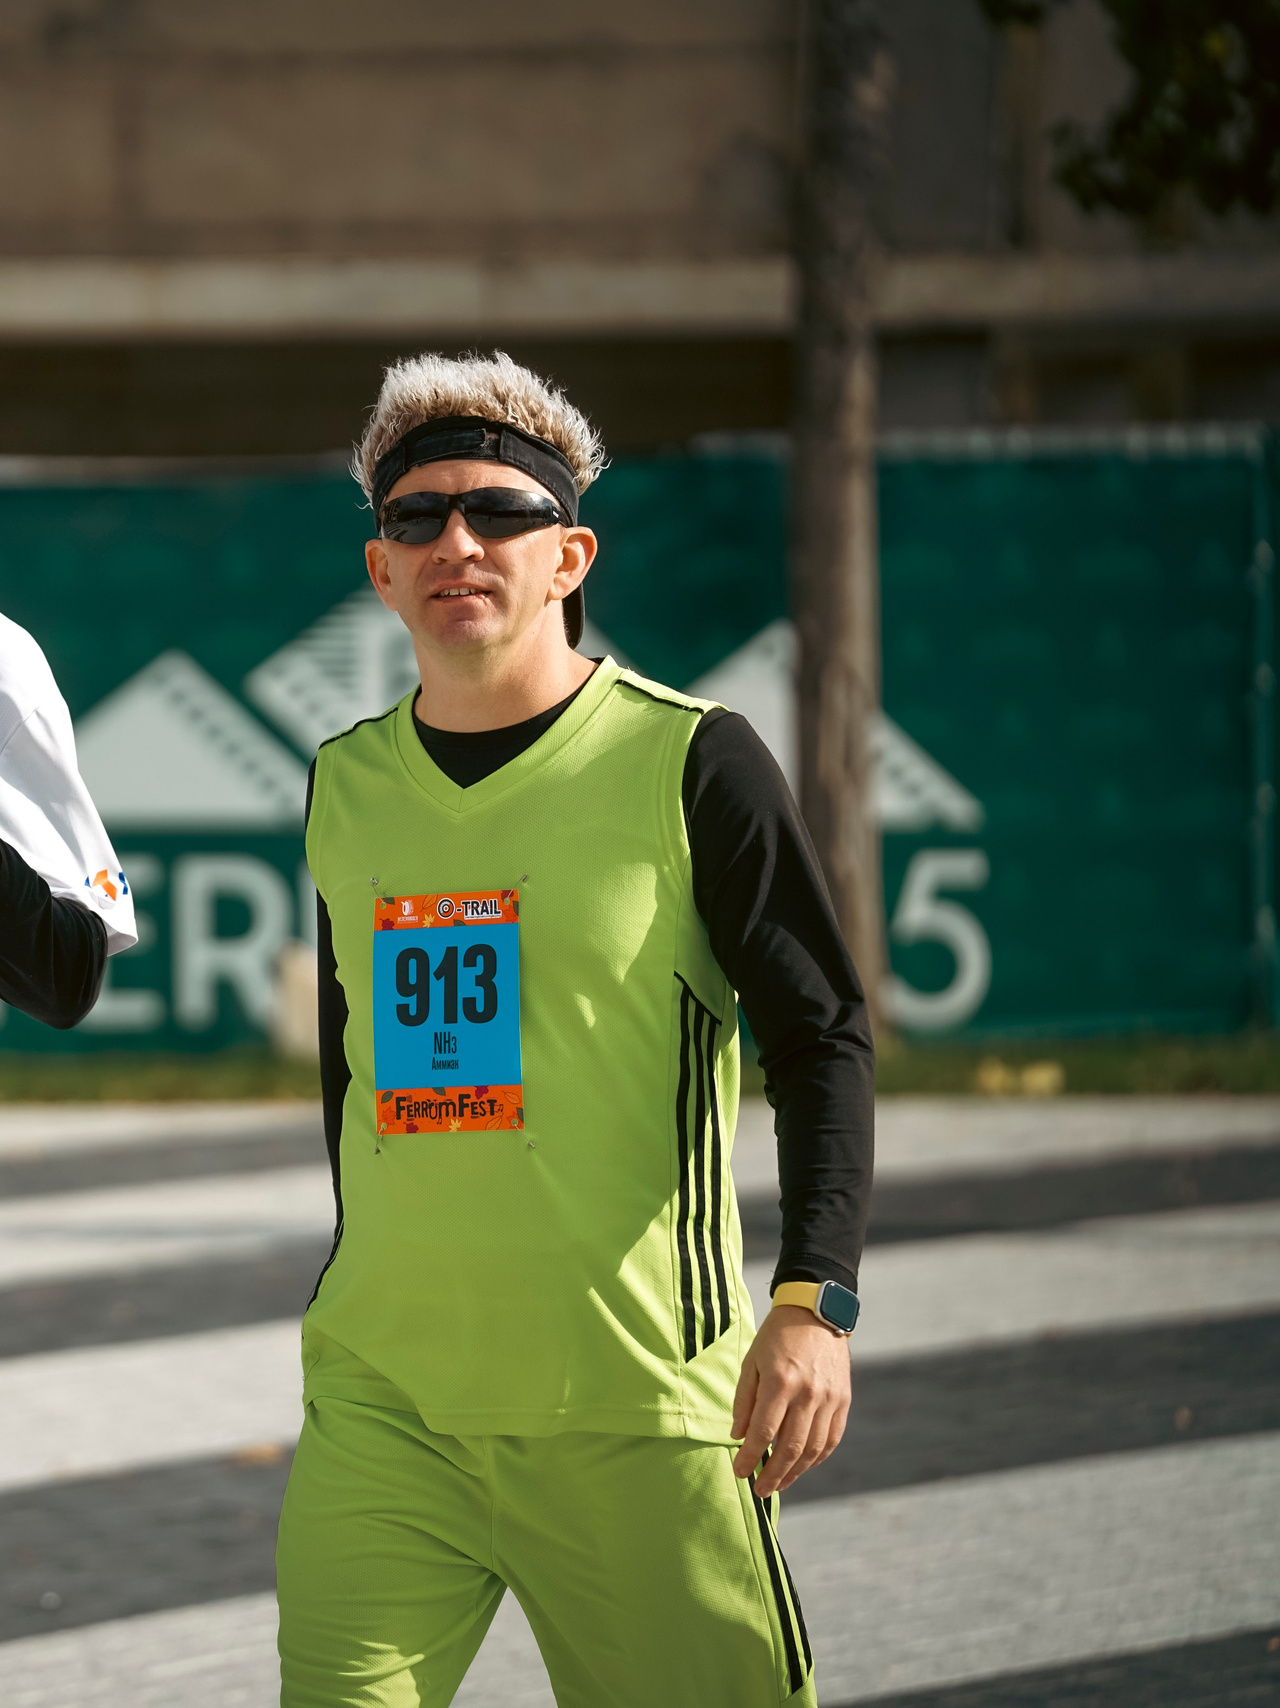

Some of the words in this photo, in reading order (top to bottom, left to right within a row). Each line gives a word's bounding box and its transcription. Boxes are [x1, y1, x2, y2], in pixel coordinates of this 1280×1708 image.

[395, 944, 498, 1027] 913
[433, 1031, 457, 1055] NH3
[431, 1056, 459, 1071] Аммиак
